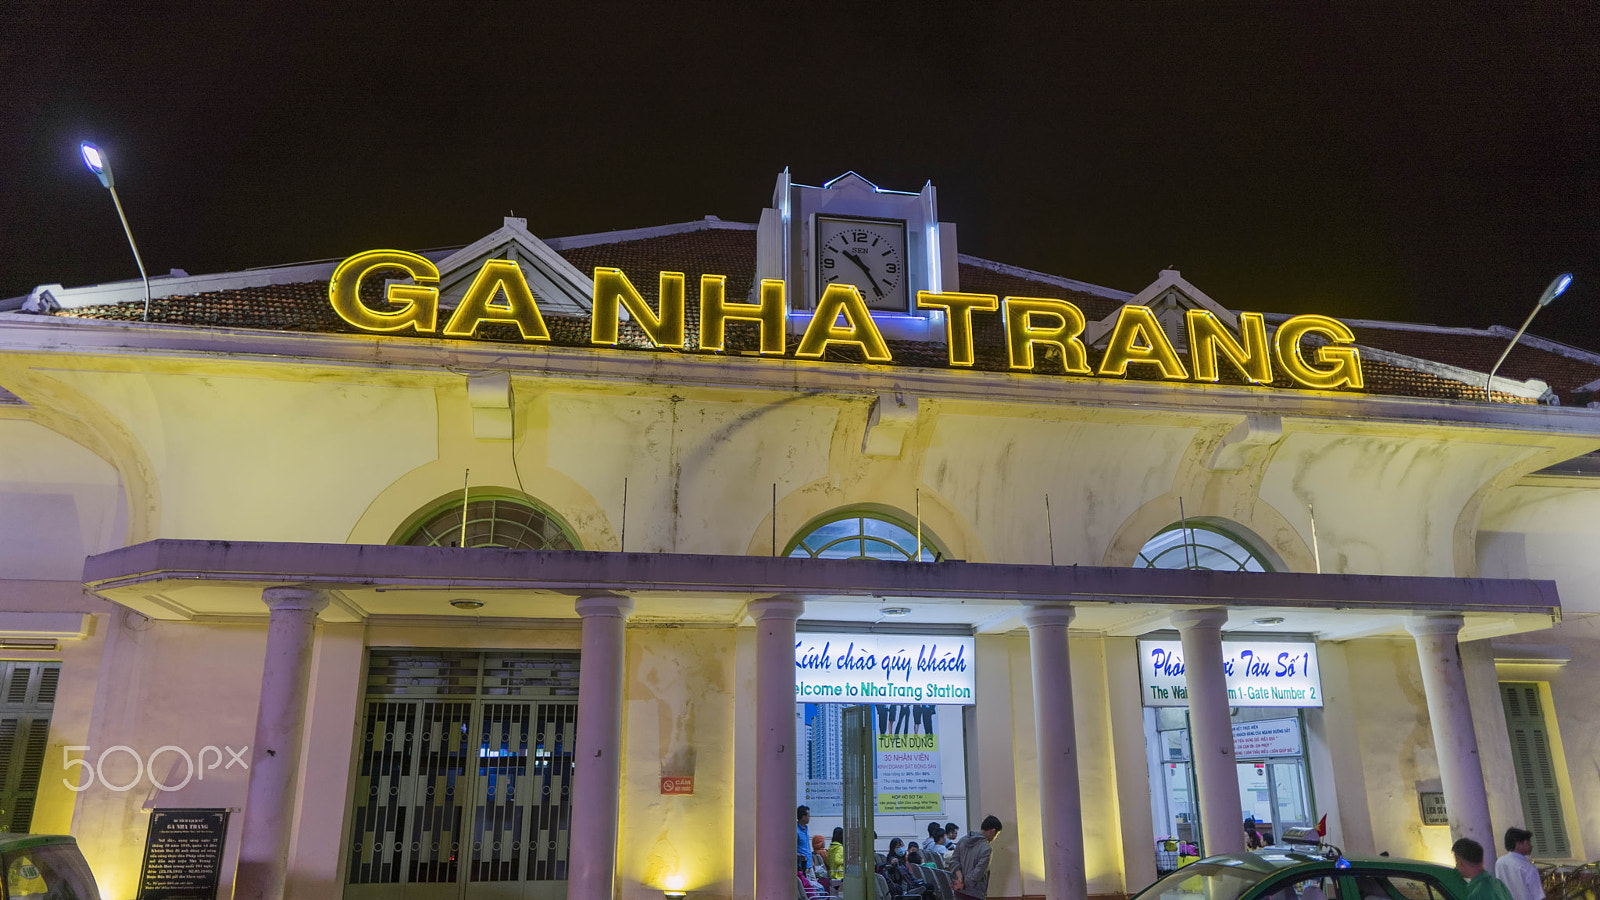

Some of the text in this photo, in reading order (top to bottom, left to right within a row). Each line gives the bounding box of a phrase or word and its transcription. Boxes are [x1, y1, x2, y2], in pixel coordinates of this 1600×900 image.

[852, 232, 868, 243] 12
[824, 258, 897, 274] 9 3
[327, 248, 1364, 390] GA NHA TRANG
[836, 641, 877, 670] chào
[881, 649, 912, 683] quý
[917, 644, 967, 673] khách
[1241, 650, 1271, 678] Tàu
[1275, 652, 1300, 678] Số
[1303, 652, 1309, 678] 1
[795, 681, 842, 697] elcome
[845, 682, 858, 697] to
[926, 684, 971, 699] Station
[1151, 686, 1169, 699] The
[1271, 687, 1306, 700] Number
[1310, 687, 1316, 700] 2
[884, 754, 892, 762] 30
